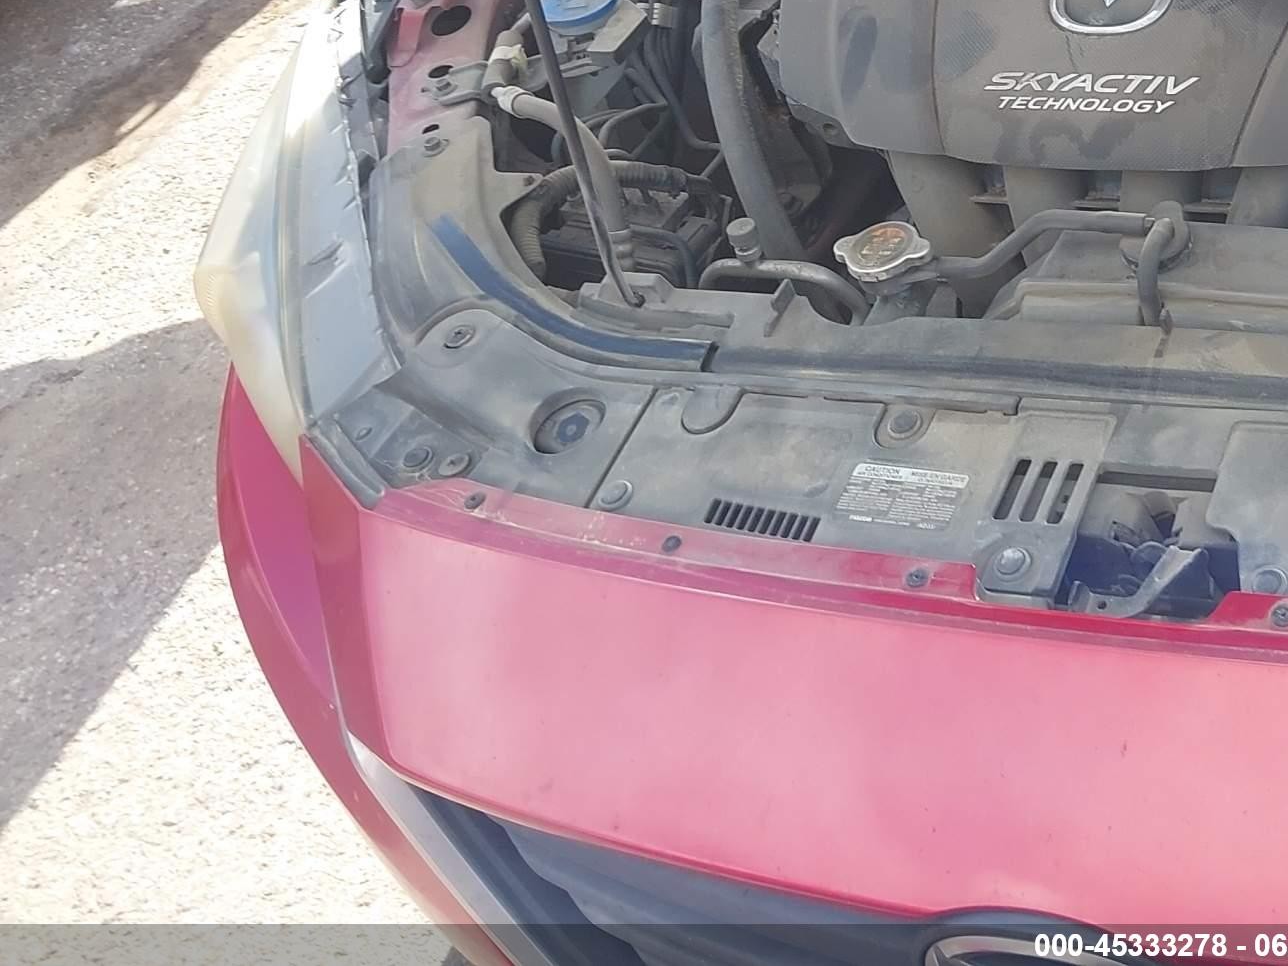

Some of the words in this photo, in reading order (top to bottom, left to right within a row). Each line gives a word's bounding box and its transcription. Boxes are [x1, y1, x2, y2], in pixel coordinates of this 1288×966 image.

[983, 71, 1200, 95] SKYACTIV
[998, 96, 1176, 114] TECHNOLOGY
[864, 465, 901, 475] CAUTION
